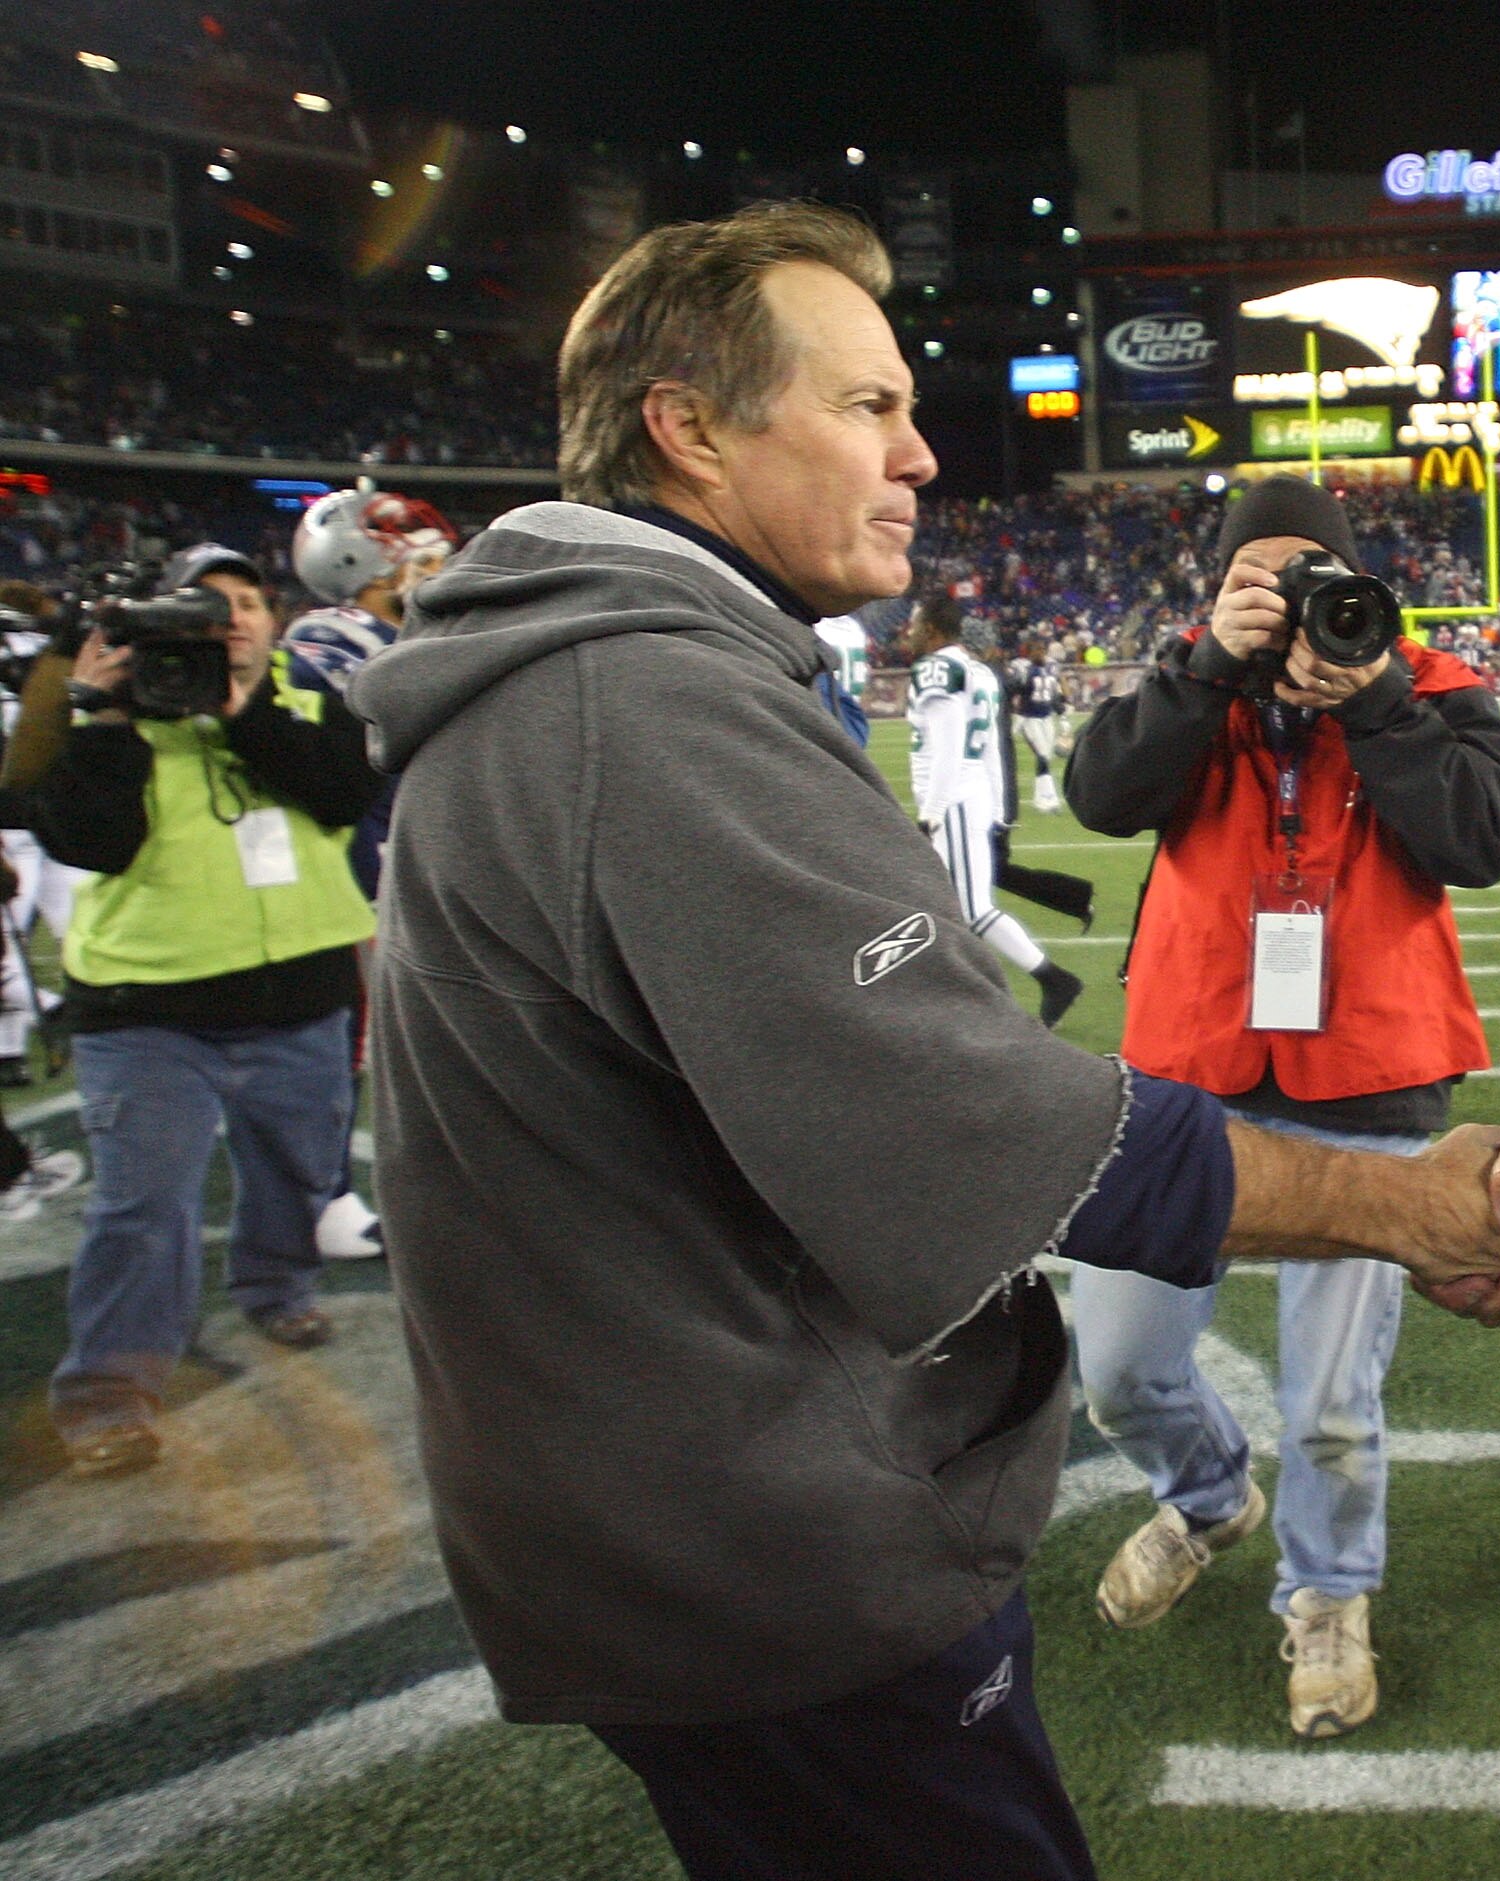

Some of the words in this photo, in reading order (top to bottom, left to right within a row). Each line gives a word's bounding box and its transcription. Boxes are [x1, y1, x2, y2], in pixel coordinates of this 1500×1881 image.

[1131, 321, 1204, 343] BUD
[1121, 339, 1218, 363] LIGHT
[1127, 428, 1191, 454] Sprint
[917, 661, 950, 688] 26
